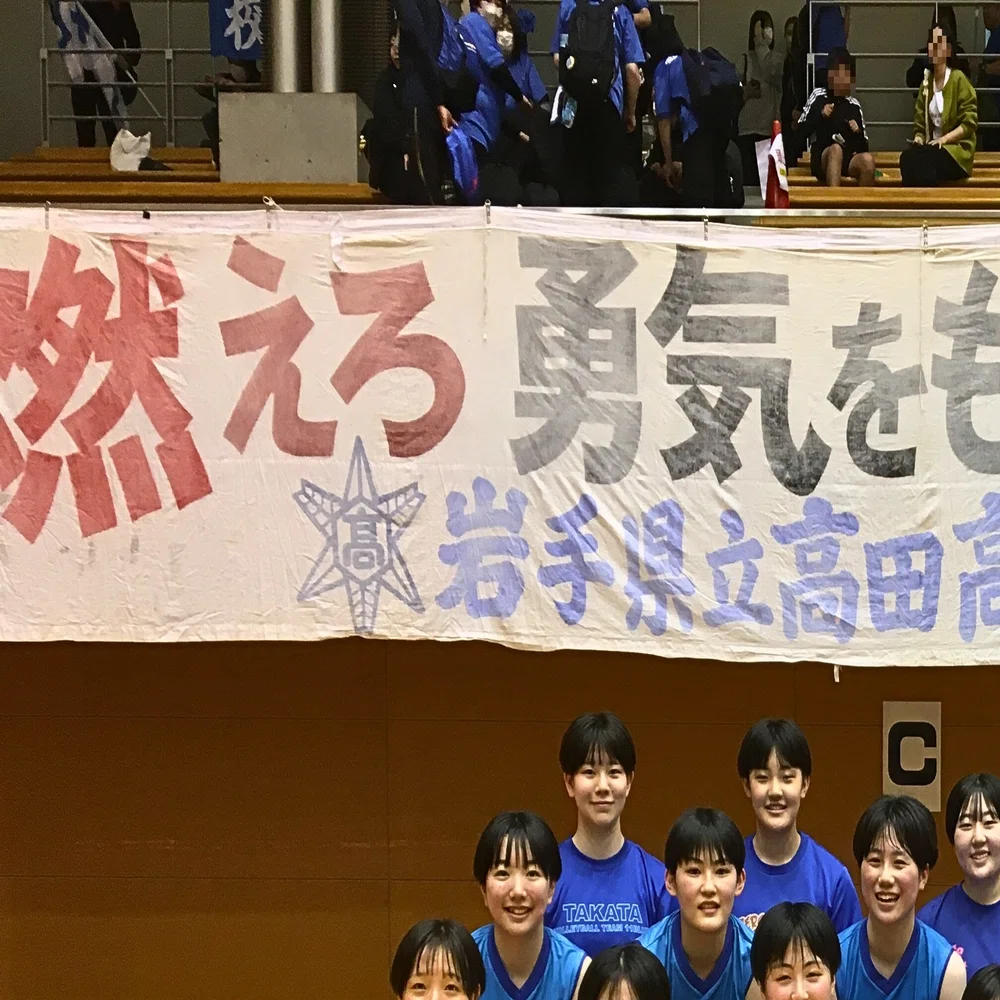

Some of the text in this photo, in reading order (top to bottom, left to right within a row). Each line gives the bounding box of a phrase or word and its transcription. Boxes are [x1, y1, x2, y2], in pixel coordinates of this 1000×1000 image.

[0, 234, 467, 544] 燃えろ
[888, 721, 938, 786] C
[562, 903, 643, 923] TAKATA
